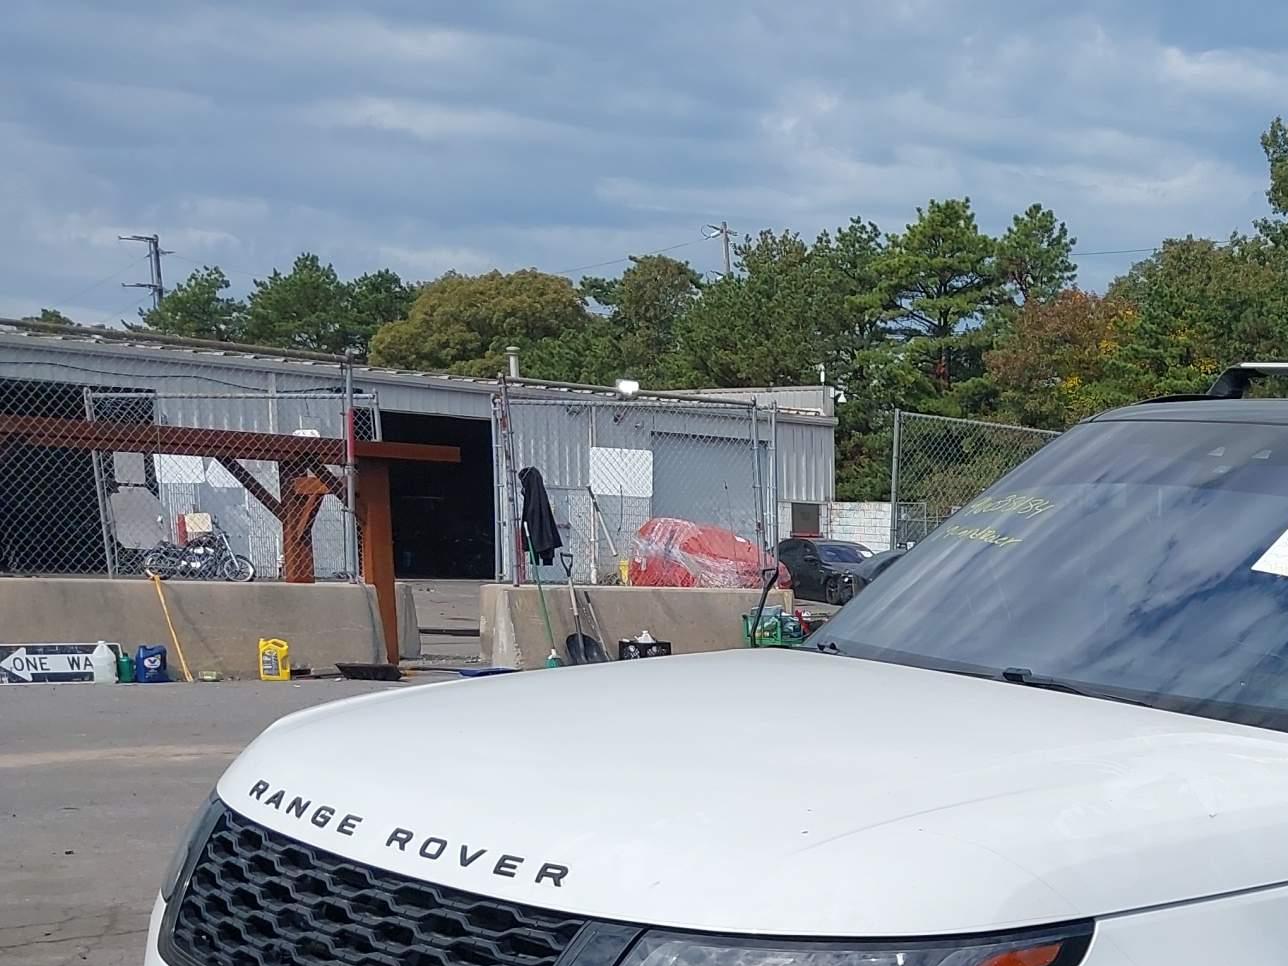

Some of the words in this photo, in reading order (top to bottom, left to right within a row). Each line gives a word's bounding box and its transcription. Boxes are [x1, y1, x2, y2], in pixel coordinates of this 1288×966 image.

[12, 656, 51, 672] ONE
[66, 655, 94, 671] WA
[248, 779, 364, 837] RANGE
[385, 827, 570, 888] ROVER
